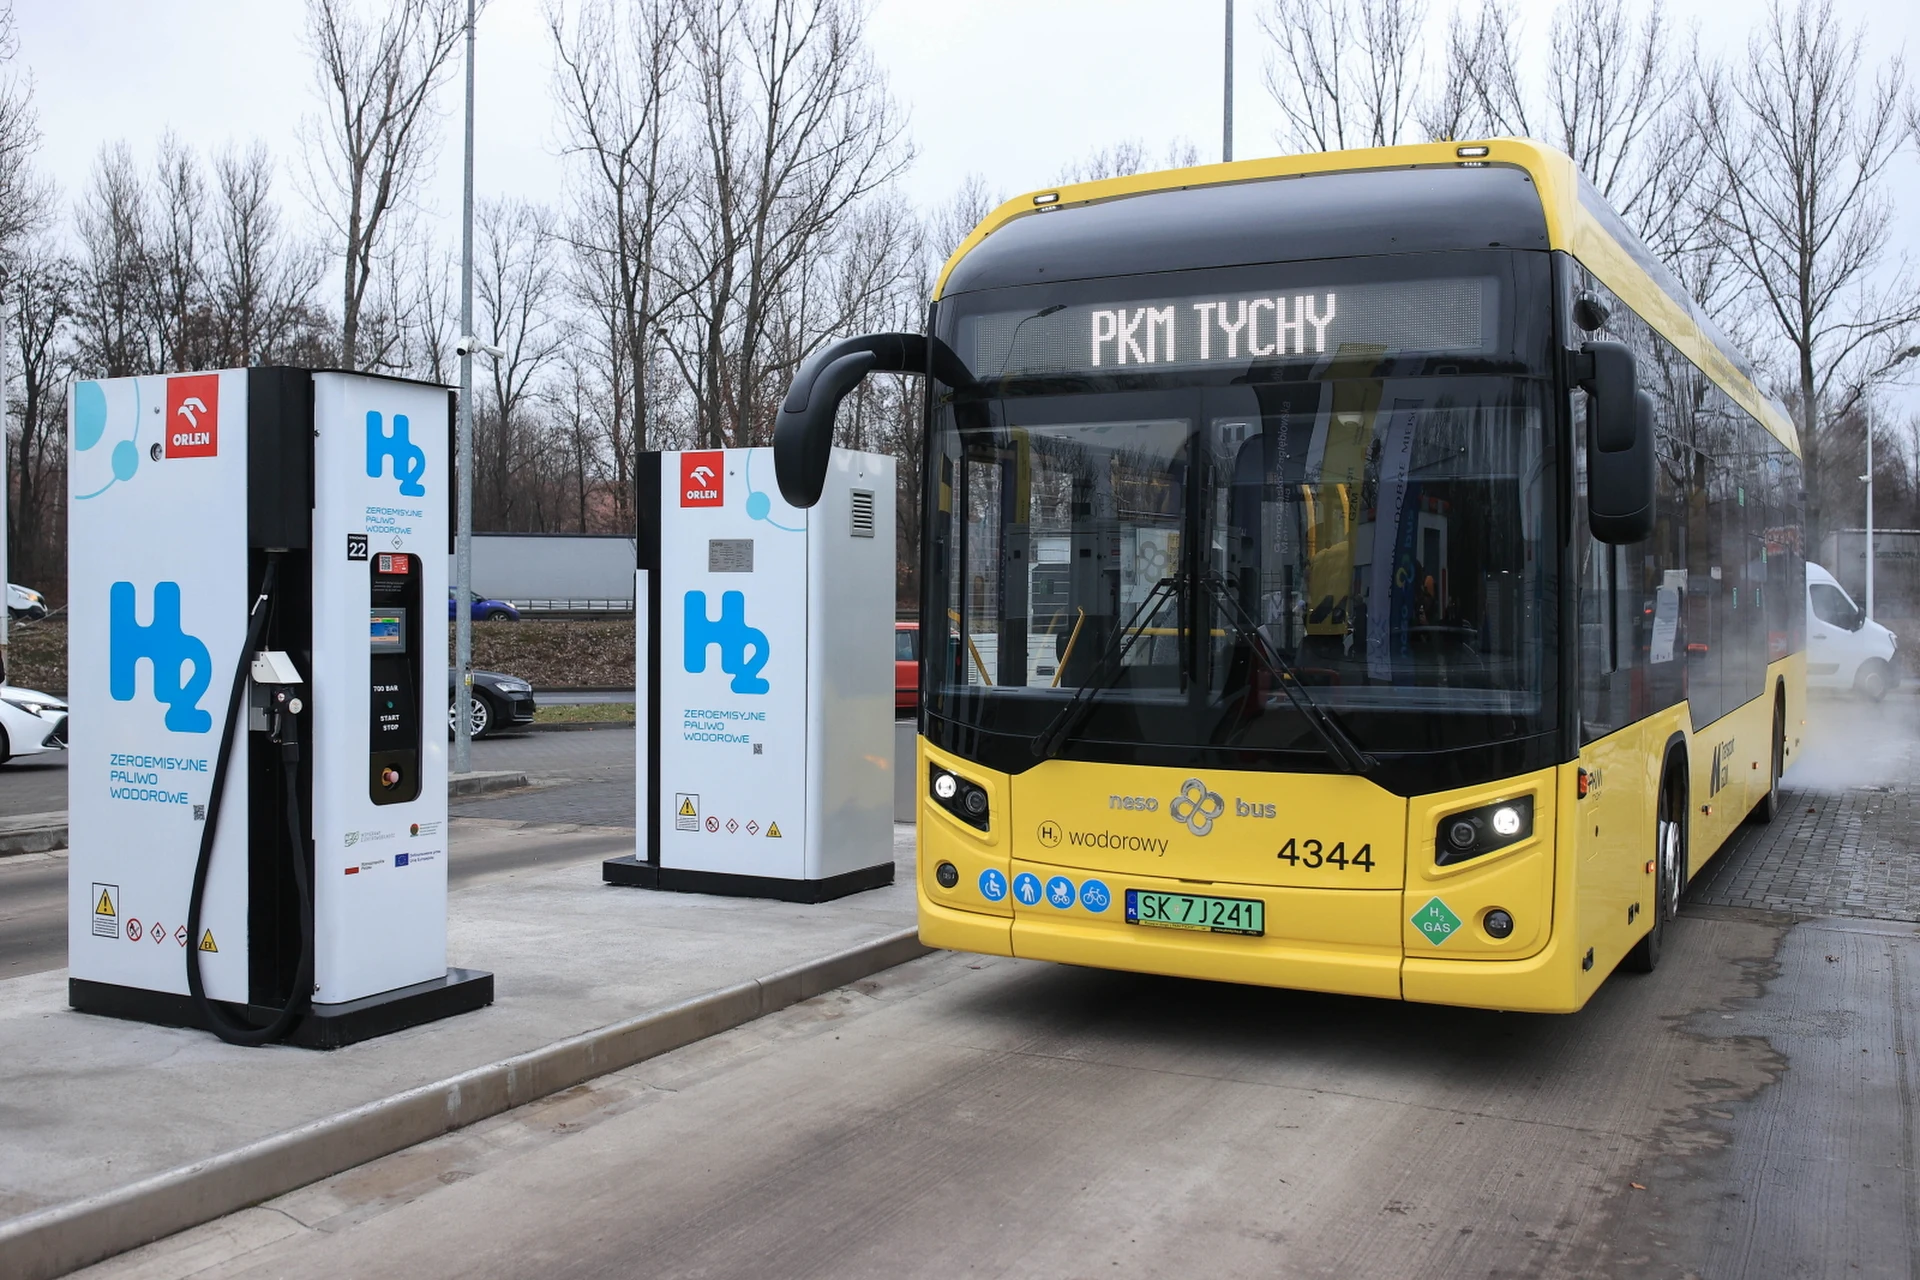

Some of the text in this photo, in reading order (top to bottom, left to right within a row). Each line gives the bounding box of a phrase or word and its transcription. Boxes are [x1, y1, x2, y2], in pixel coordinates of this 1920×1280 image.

[1092, 294, 1335, 367] PKM TYCHY
[172, 431, 210, 447] ORLEN
[366, 410, 425, 497] H2
[686, 490, 718, 500] ORLEN
[366, 506, 423, 518] ZEROEMISYJNE
[1349, 492, 1359, 521] GZM
[366, 516, 396, 525] PALIWO
[366, 525, 412, 535] WODOROWE
[349, 542, 366, 557] 22
[684, 590, 769, 695] H2
[110, 581, 212, 733] H2
[380, 714, 400, 722] START
[684, 709, 766, 721] ZEROEMISYJNE
[684, 721, 725, 731] PALIWO
[684, 732, 750, 743] WODOROWE
[110, 754, 208, 772] ZEROEMISYJNE
[110, 771, 158, 785] PALIWO
[110, 787, 189, 804] WODOROWE
[1109, 795, 1278, 818] neso bus
[1069, 830, 1169, 857] wodorowy
[1277, 838, 1375, 873] 4344
[1142, 895, 1171, 920] SK
[1181, 898, 1252, 928] 7J241
[1424, 922, 1451, 933] GAS
[204, 941, 213, 950] EX
